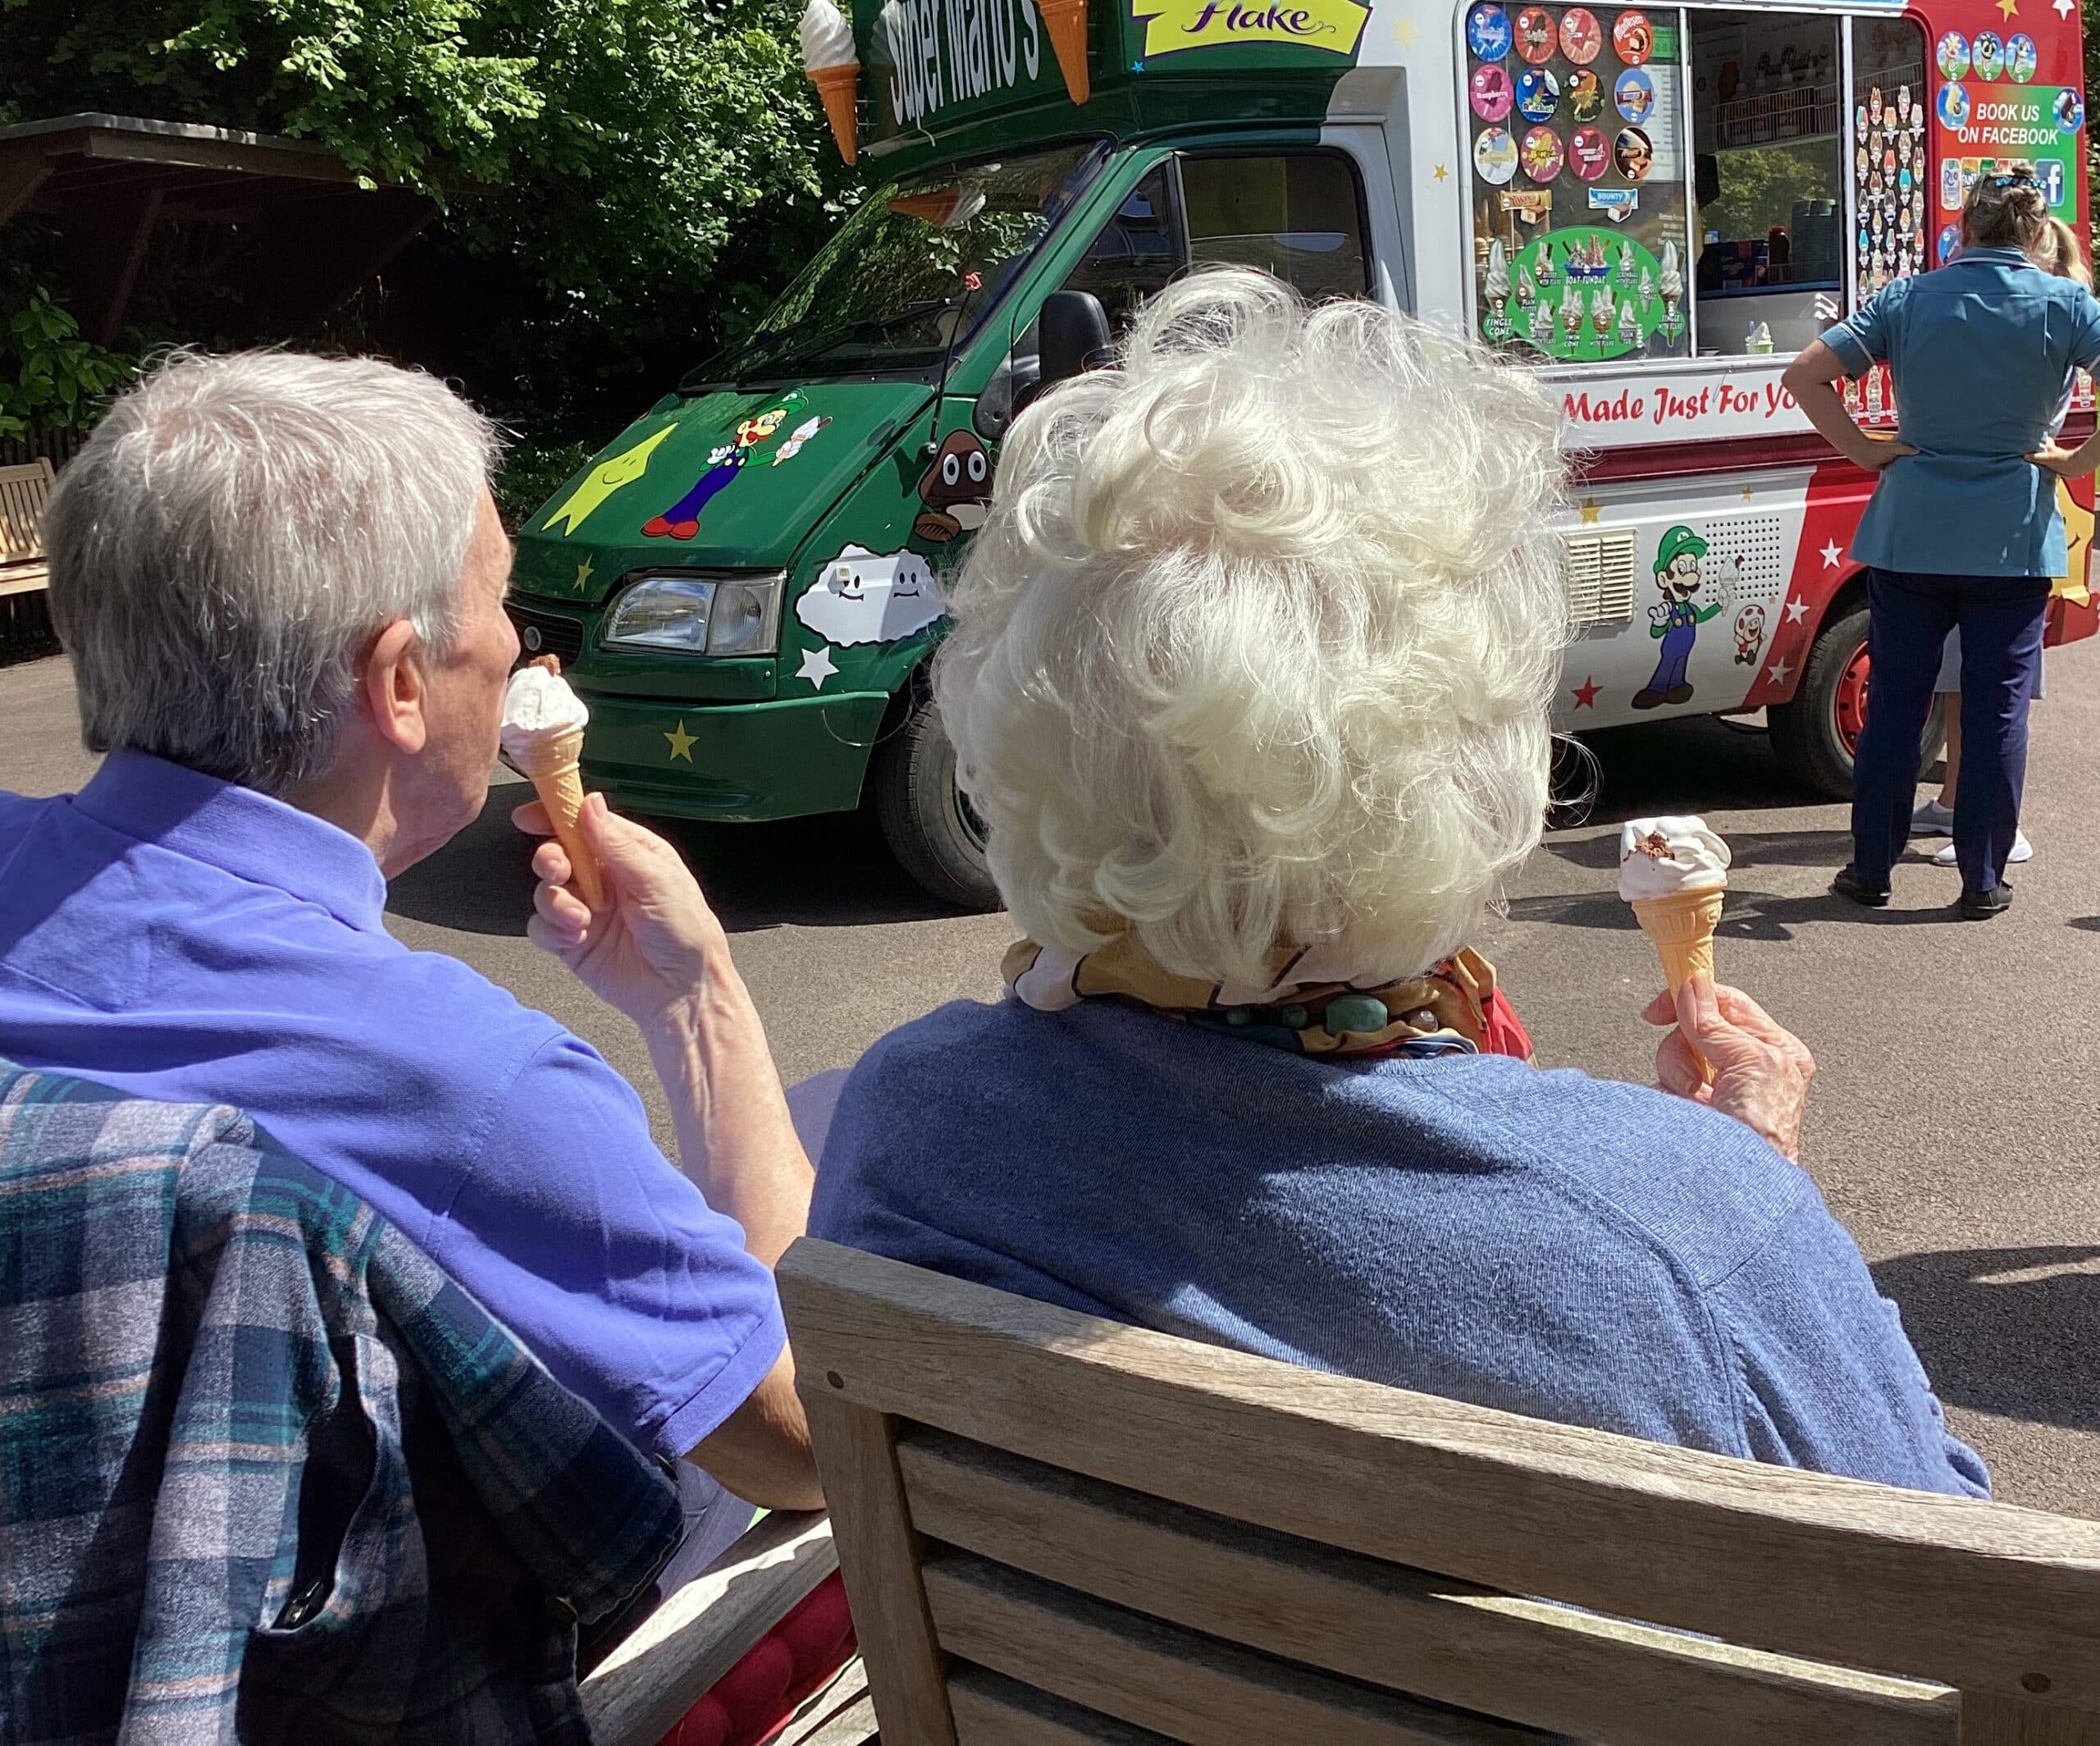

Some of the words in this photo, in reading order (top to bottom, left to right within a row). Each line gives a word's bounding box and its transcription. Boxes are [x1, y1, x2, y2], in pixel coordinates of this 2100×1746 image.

[1976, 103, 2019, 121] BOOK
[2021, 104, 2040, 121] US
[1957, 127, 1979, 144] ON
[1982, 127, 2059, 145] FACEBOOK
[1596, 192, 1623, 201] BOUNTY
[1486, 318, 1513, 327] SINGLE
[1489, 327, 1510, 336] CONE
[1564, 388, 1644, 423] Made
[1653, 386, 1709, 426] Just
[1719, 384, 1759, 415] For
[1765, 382, 1799, 418] Yo
